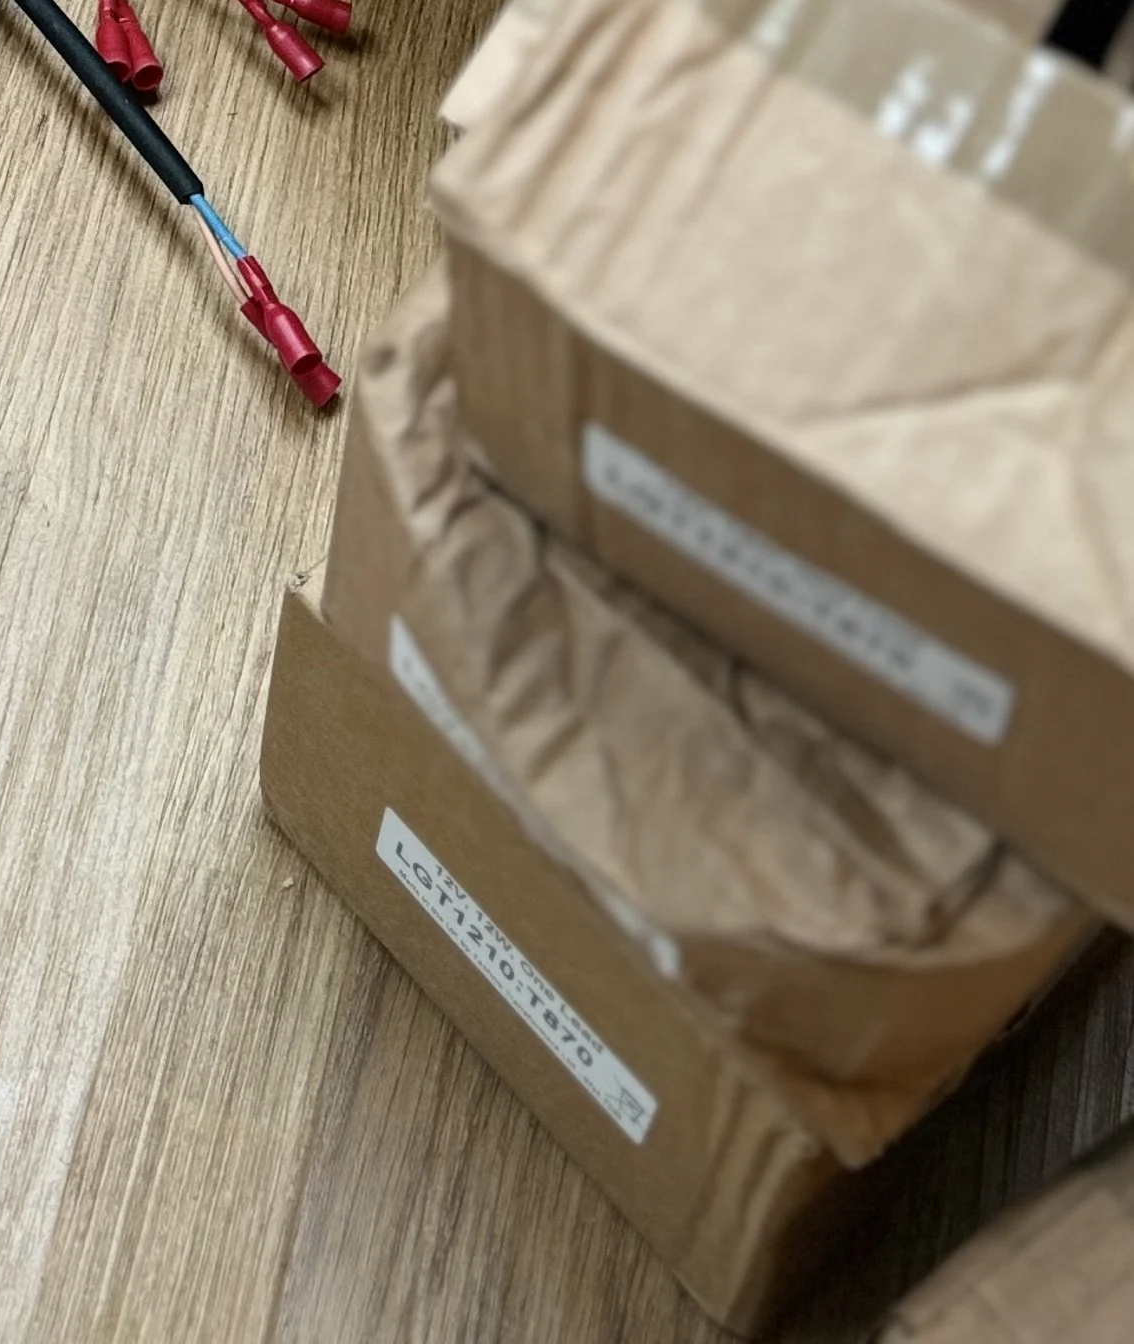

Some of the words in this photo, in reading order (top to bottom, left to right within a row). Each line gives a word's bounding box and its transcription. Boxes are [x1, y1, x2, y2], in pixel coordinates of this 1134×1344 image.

[395, 841, 594, 1069] LGT1210:T870
[518, 959, 556, 1002] One
[558, 997, 605, 1055] Lead
